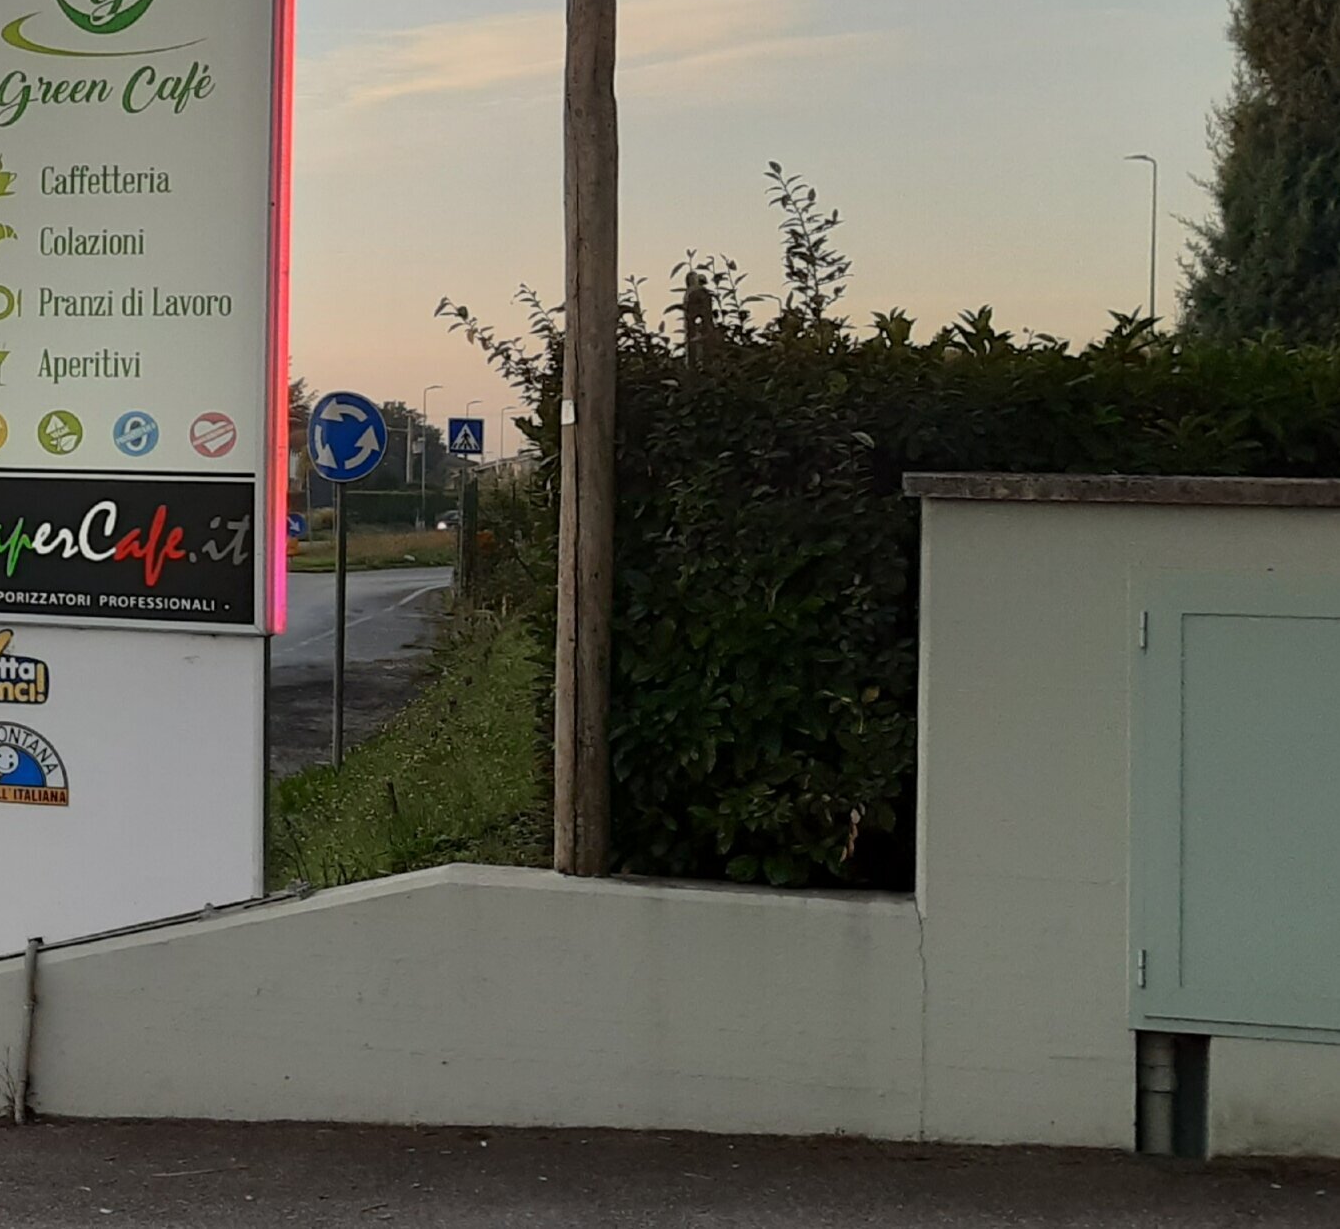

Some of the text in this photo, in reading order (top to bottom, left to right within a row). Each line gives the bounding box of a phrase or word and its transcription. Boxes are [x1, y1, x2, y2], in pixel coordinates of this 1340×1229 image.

[121, 61, 215, 114] Café
[40, 165, 172, 196] Caffetteria
[38, 226, 145, 257] Colazioni
[38, 286, 233, 318] Pranzi di Lavoro
[37, 348, 141, 385] Aperitivi
[98, 594, 216, 612] PROFESSIONALI
